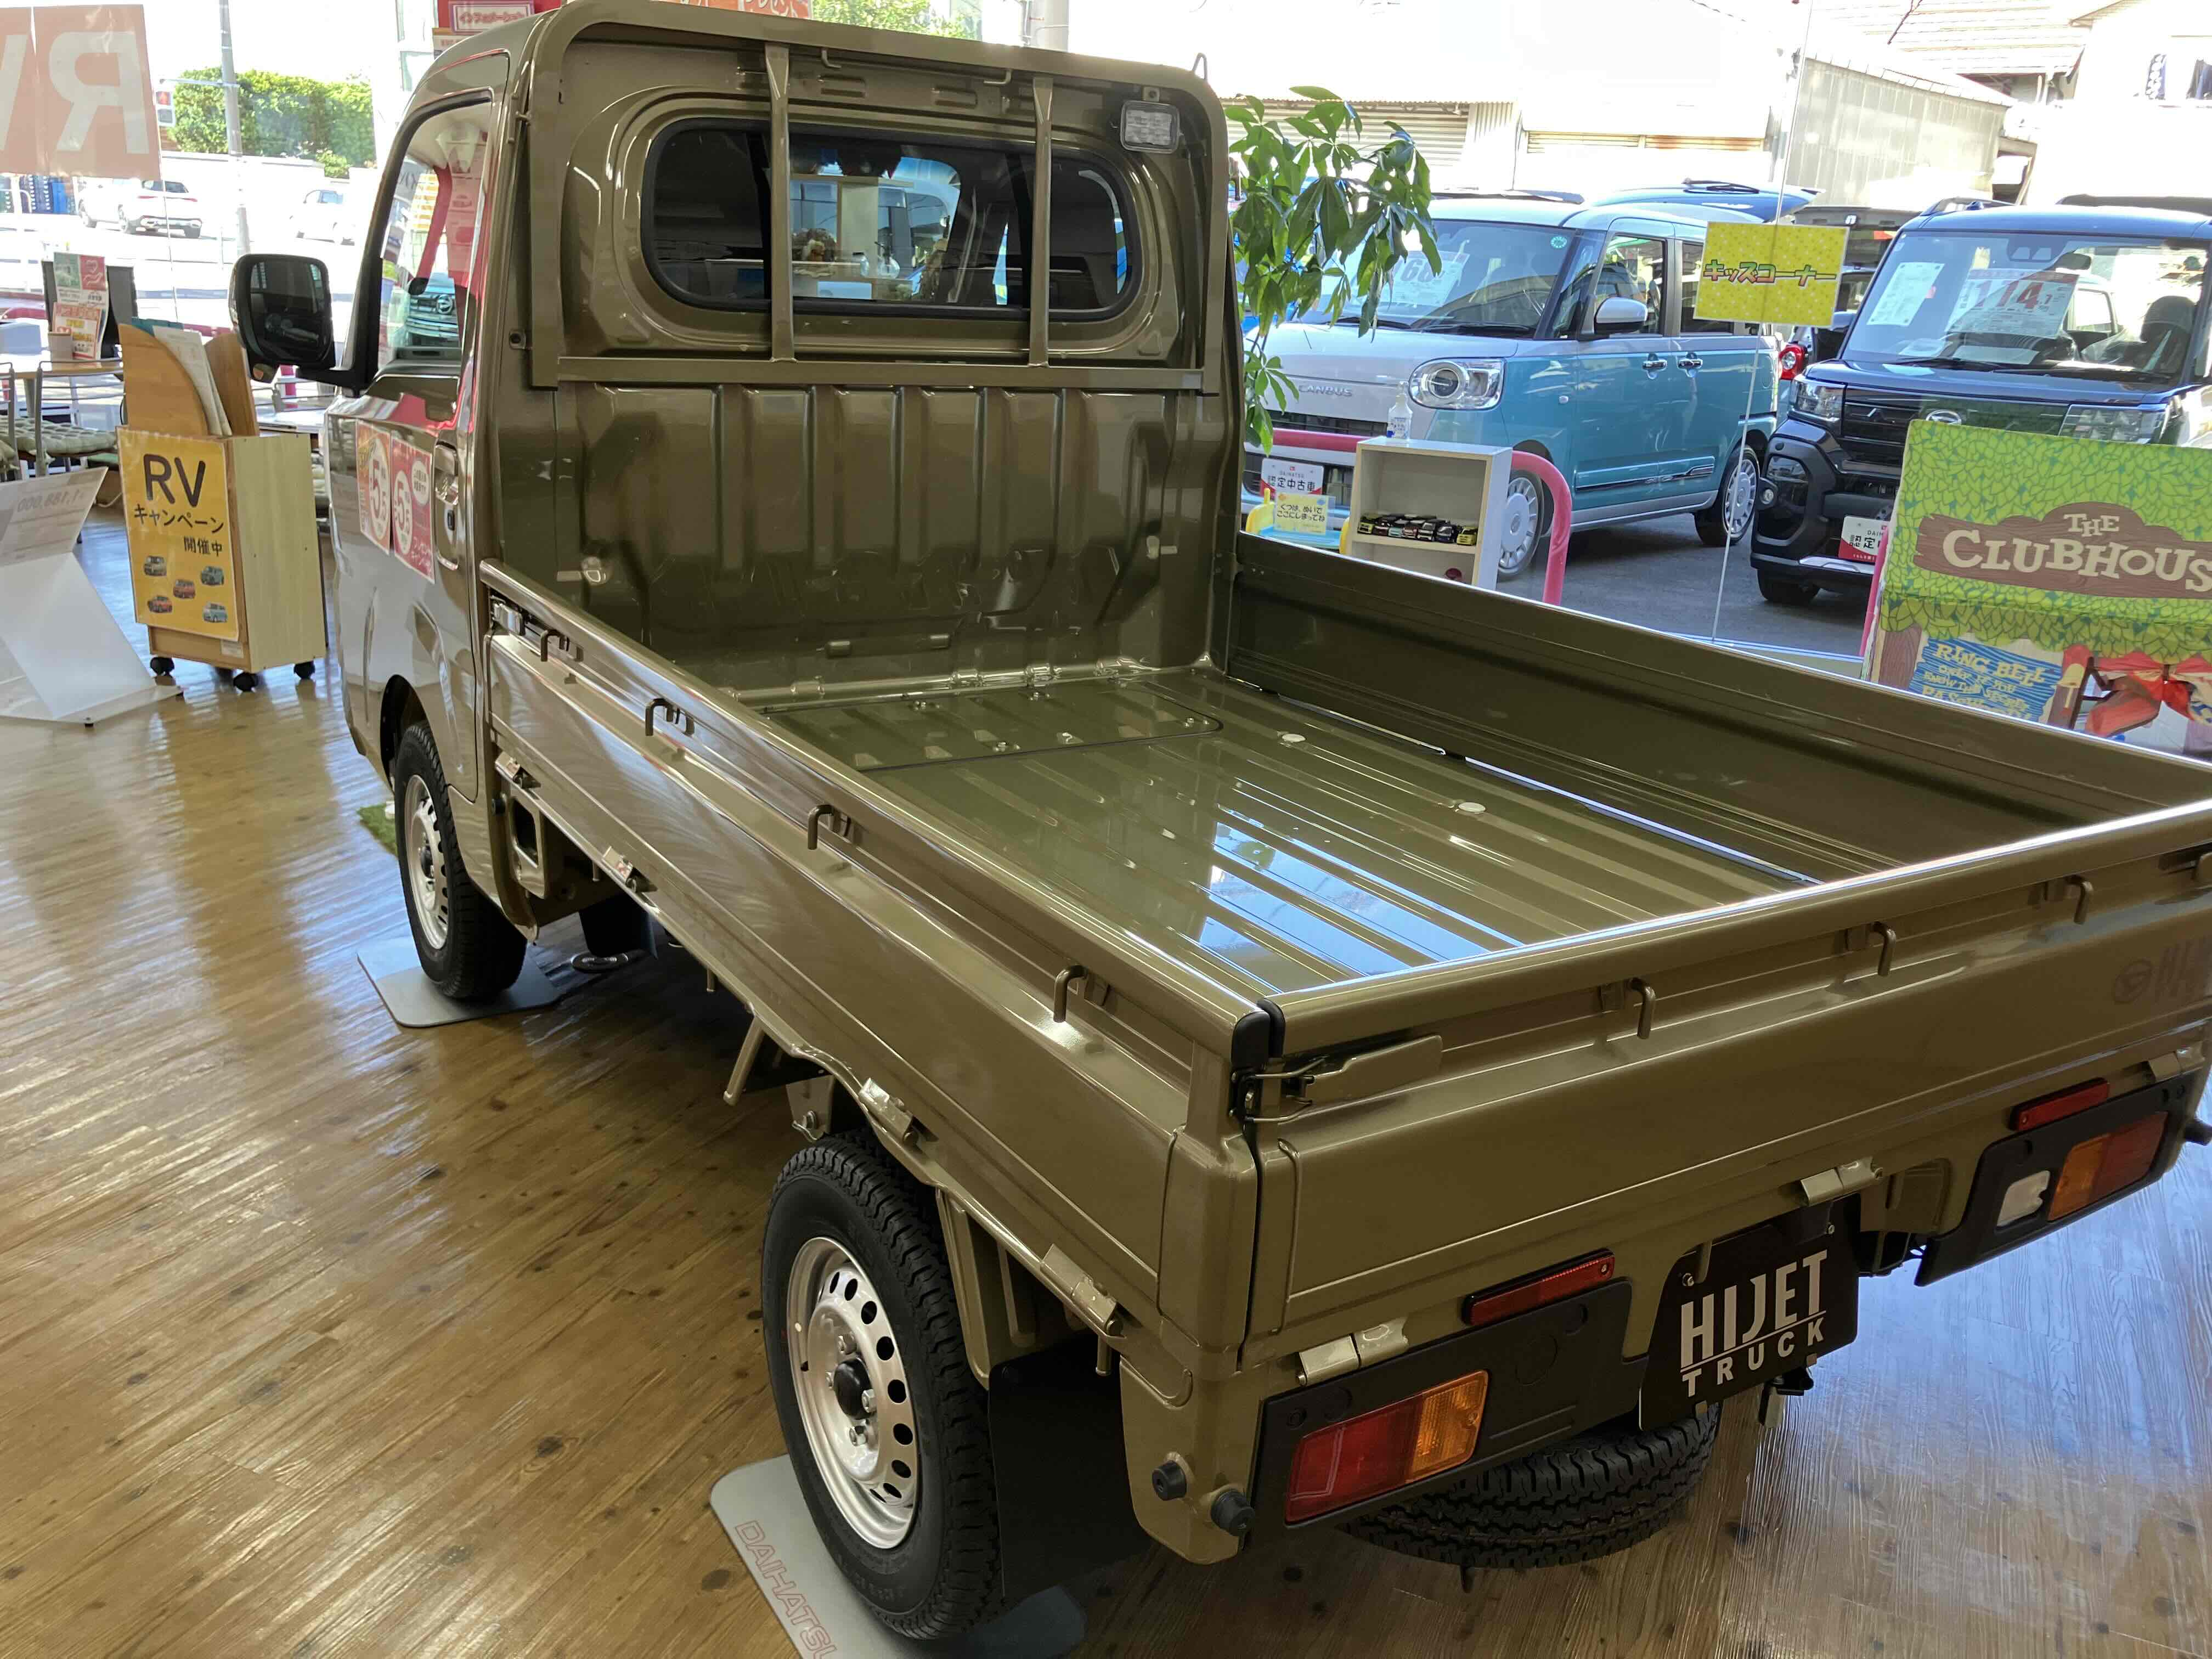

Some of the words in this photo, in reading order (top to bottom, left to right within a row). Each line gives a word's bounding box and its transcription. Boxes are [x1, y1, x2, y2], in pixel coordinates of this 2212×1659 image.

[1702, 259, 1837, 287] キッズコーナー
[1299, 385, 1352, 397] CANBUS
[143, 454, 206, 507] RV
[1268, 475, 1316, 492] 認定中古車
[134, 503, 224, 534] キャンペーン
[1277, 510, 1325, 522] ここにしまってね
[2064, 513, 2120, 537] THE
[184, 536, 223, 557] 開催中
[1849, 534, 1880, 549] 認定
[1933, 644, 1989, 673] RING
[1993, 661, 2046, 686] BELL
[1680, 1249, 1827, 1369] HIJET
[1682, 1317, 1824, 1397] TRUCK
